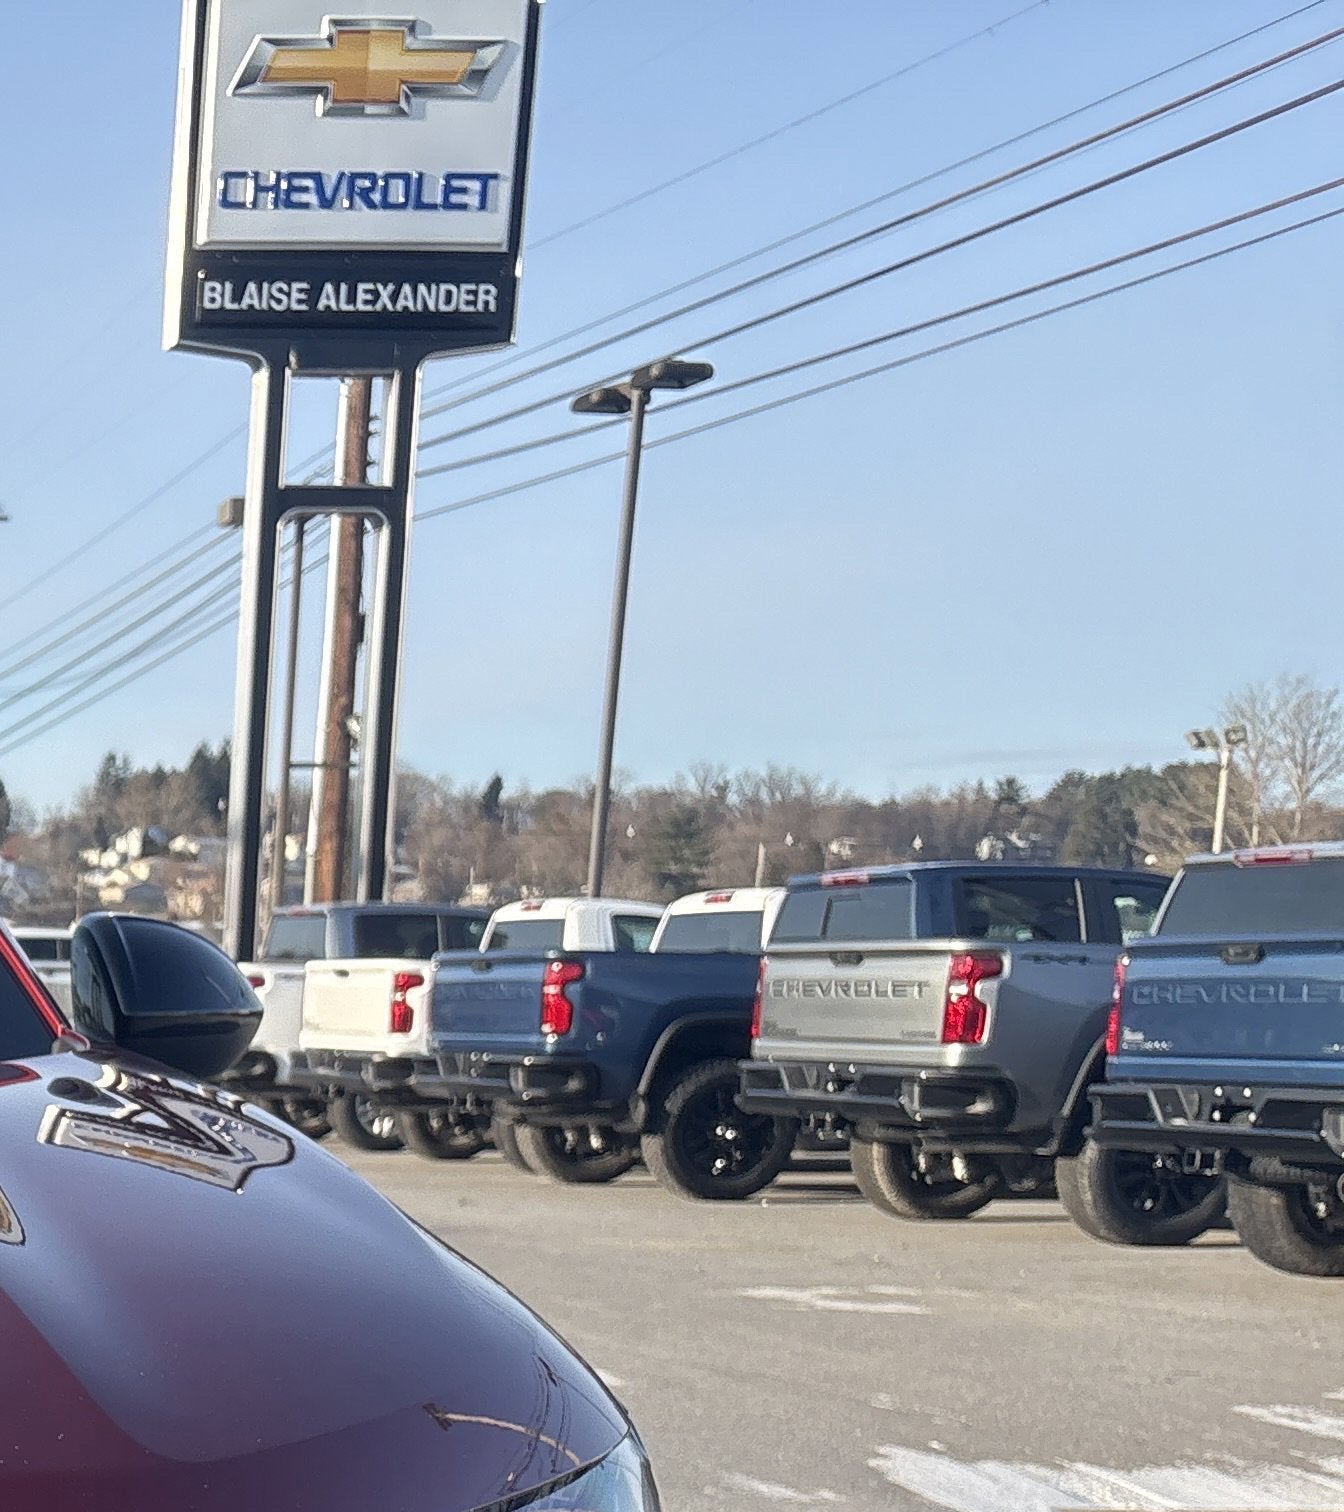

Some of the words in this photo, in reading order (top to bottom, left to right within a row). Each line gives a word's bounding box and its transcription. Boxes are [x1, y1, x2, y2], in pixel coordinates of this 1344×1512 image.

[218, 170, 499, 210] CHEVROLET
[203, 281, 309, 311] BLAISE
[317, 282, 499, 313] ALEXANDER
[769, 979, 931, 1000] CHEVROLET
